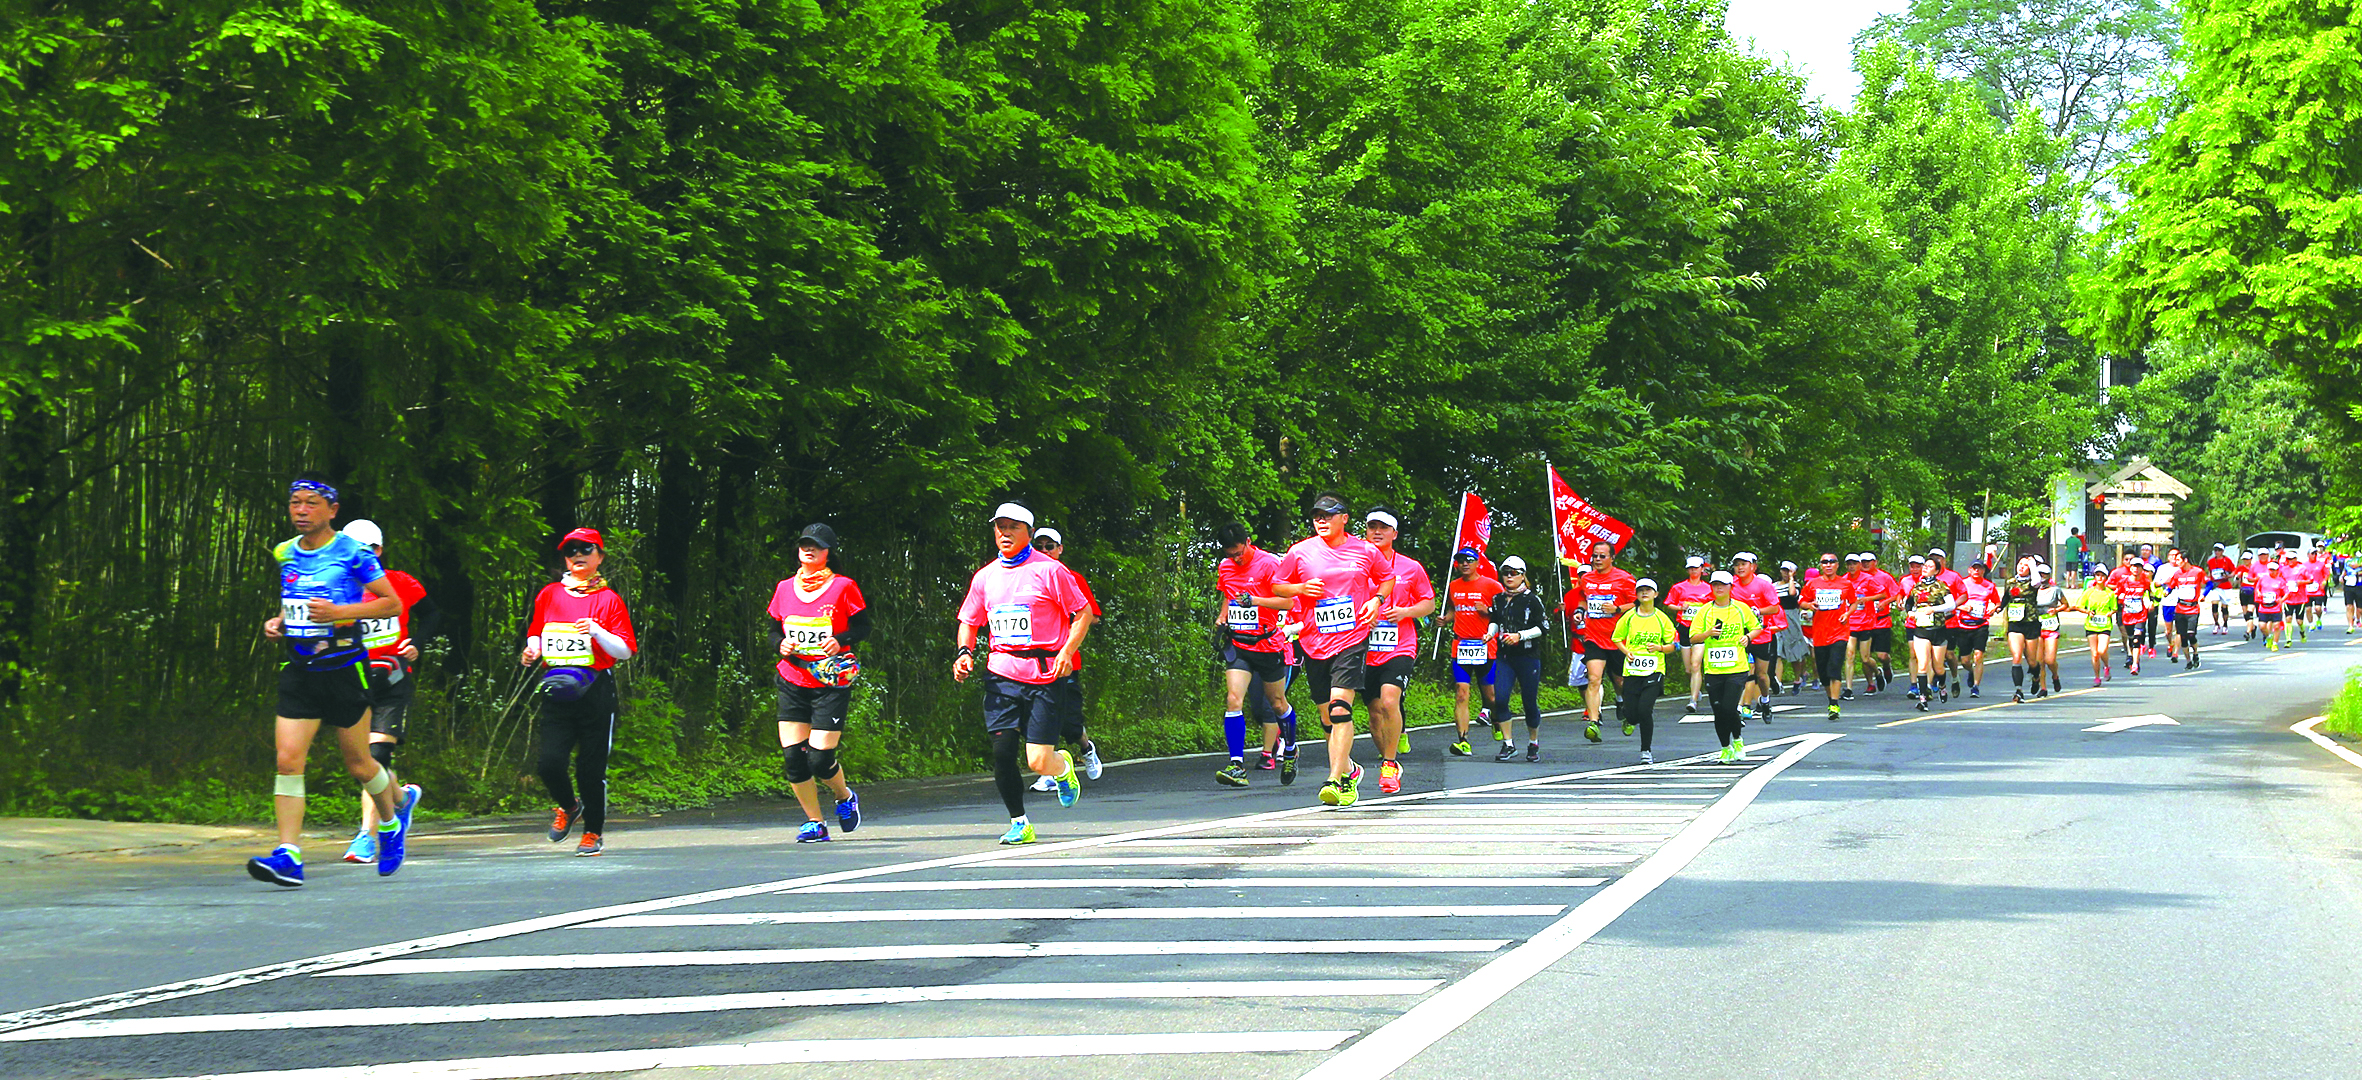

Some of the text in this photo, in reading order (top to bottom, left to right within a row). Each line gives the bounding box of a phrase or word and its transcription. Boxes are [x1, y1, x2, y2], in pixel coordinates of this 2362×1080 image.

[1229, 610, 1257, 620] M169
[1316, 607, 1353, 622] M162
[362, 618, 392, 634] 027
[990, 617, 1029, 631] M170
[789, 630, 827, 643] F026
[547, 638, 587, 651] F023
[1459, 648, 1486, 658] M075
[1709, 649, 1734, 659] F079
